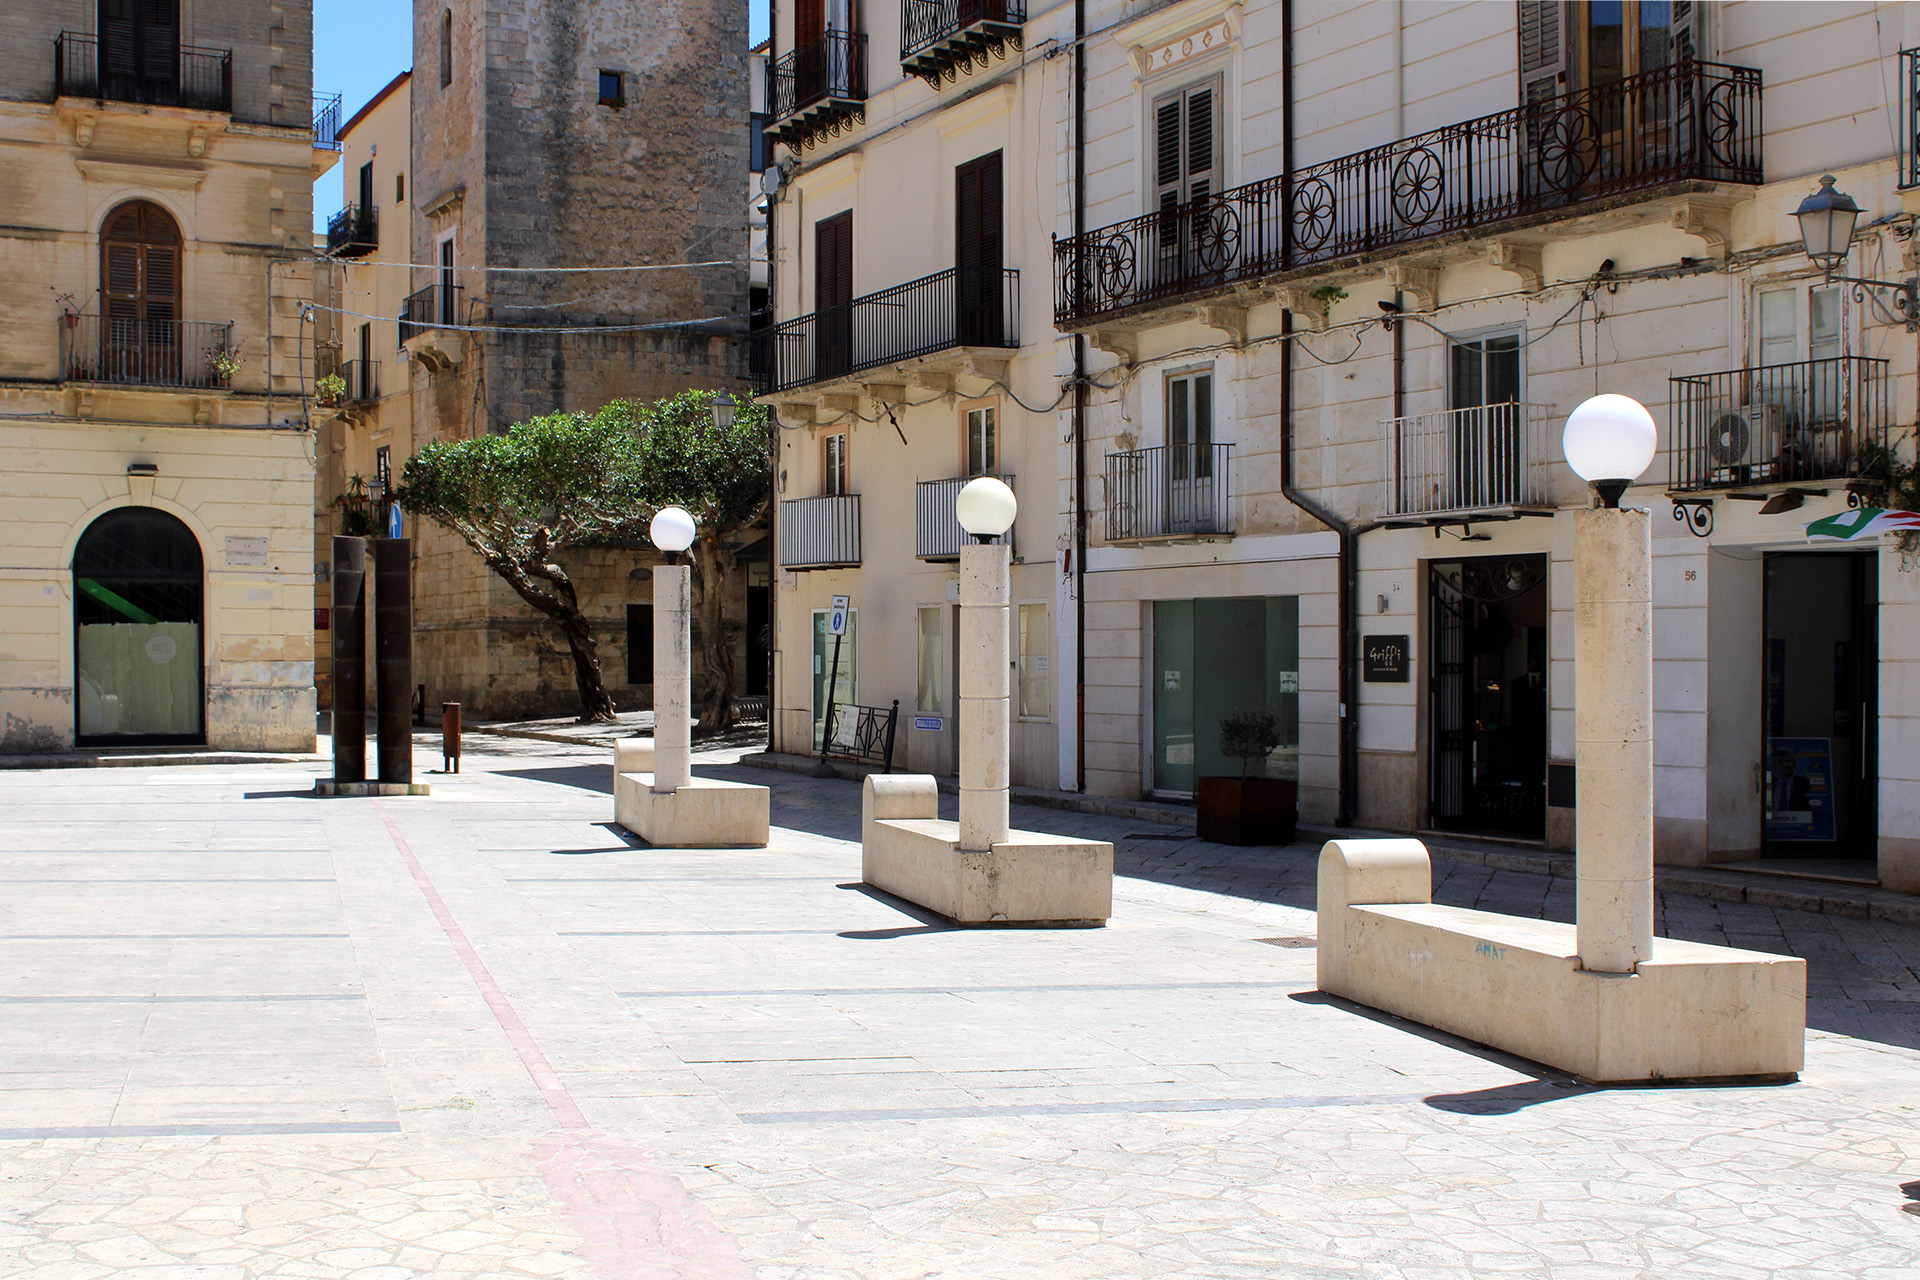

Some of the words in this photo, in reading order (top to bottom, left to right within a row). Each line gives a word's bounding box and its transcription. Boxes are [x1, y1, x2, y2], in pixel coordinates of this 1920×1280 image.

[1685, 570, 1696, 581] 56
[1392, 584, 1400, 592] 54
[1475, 940, 1507, 960] AMAT
